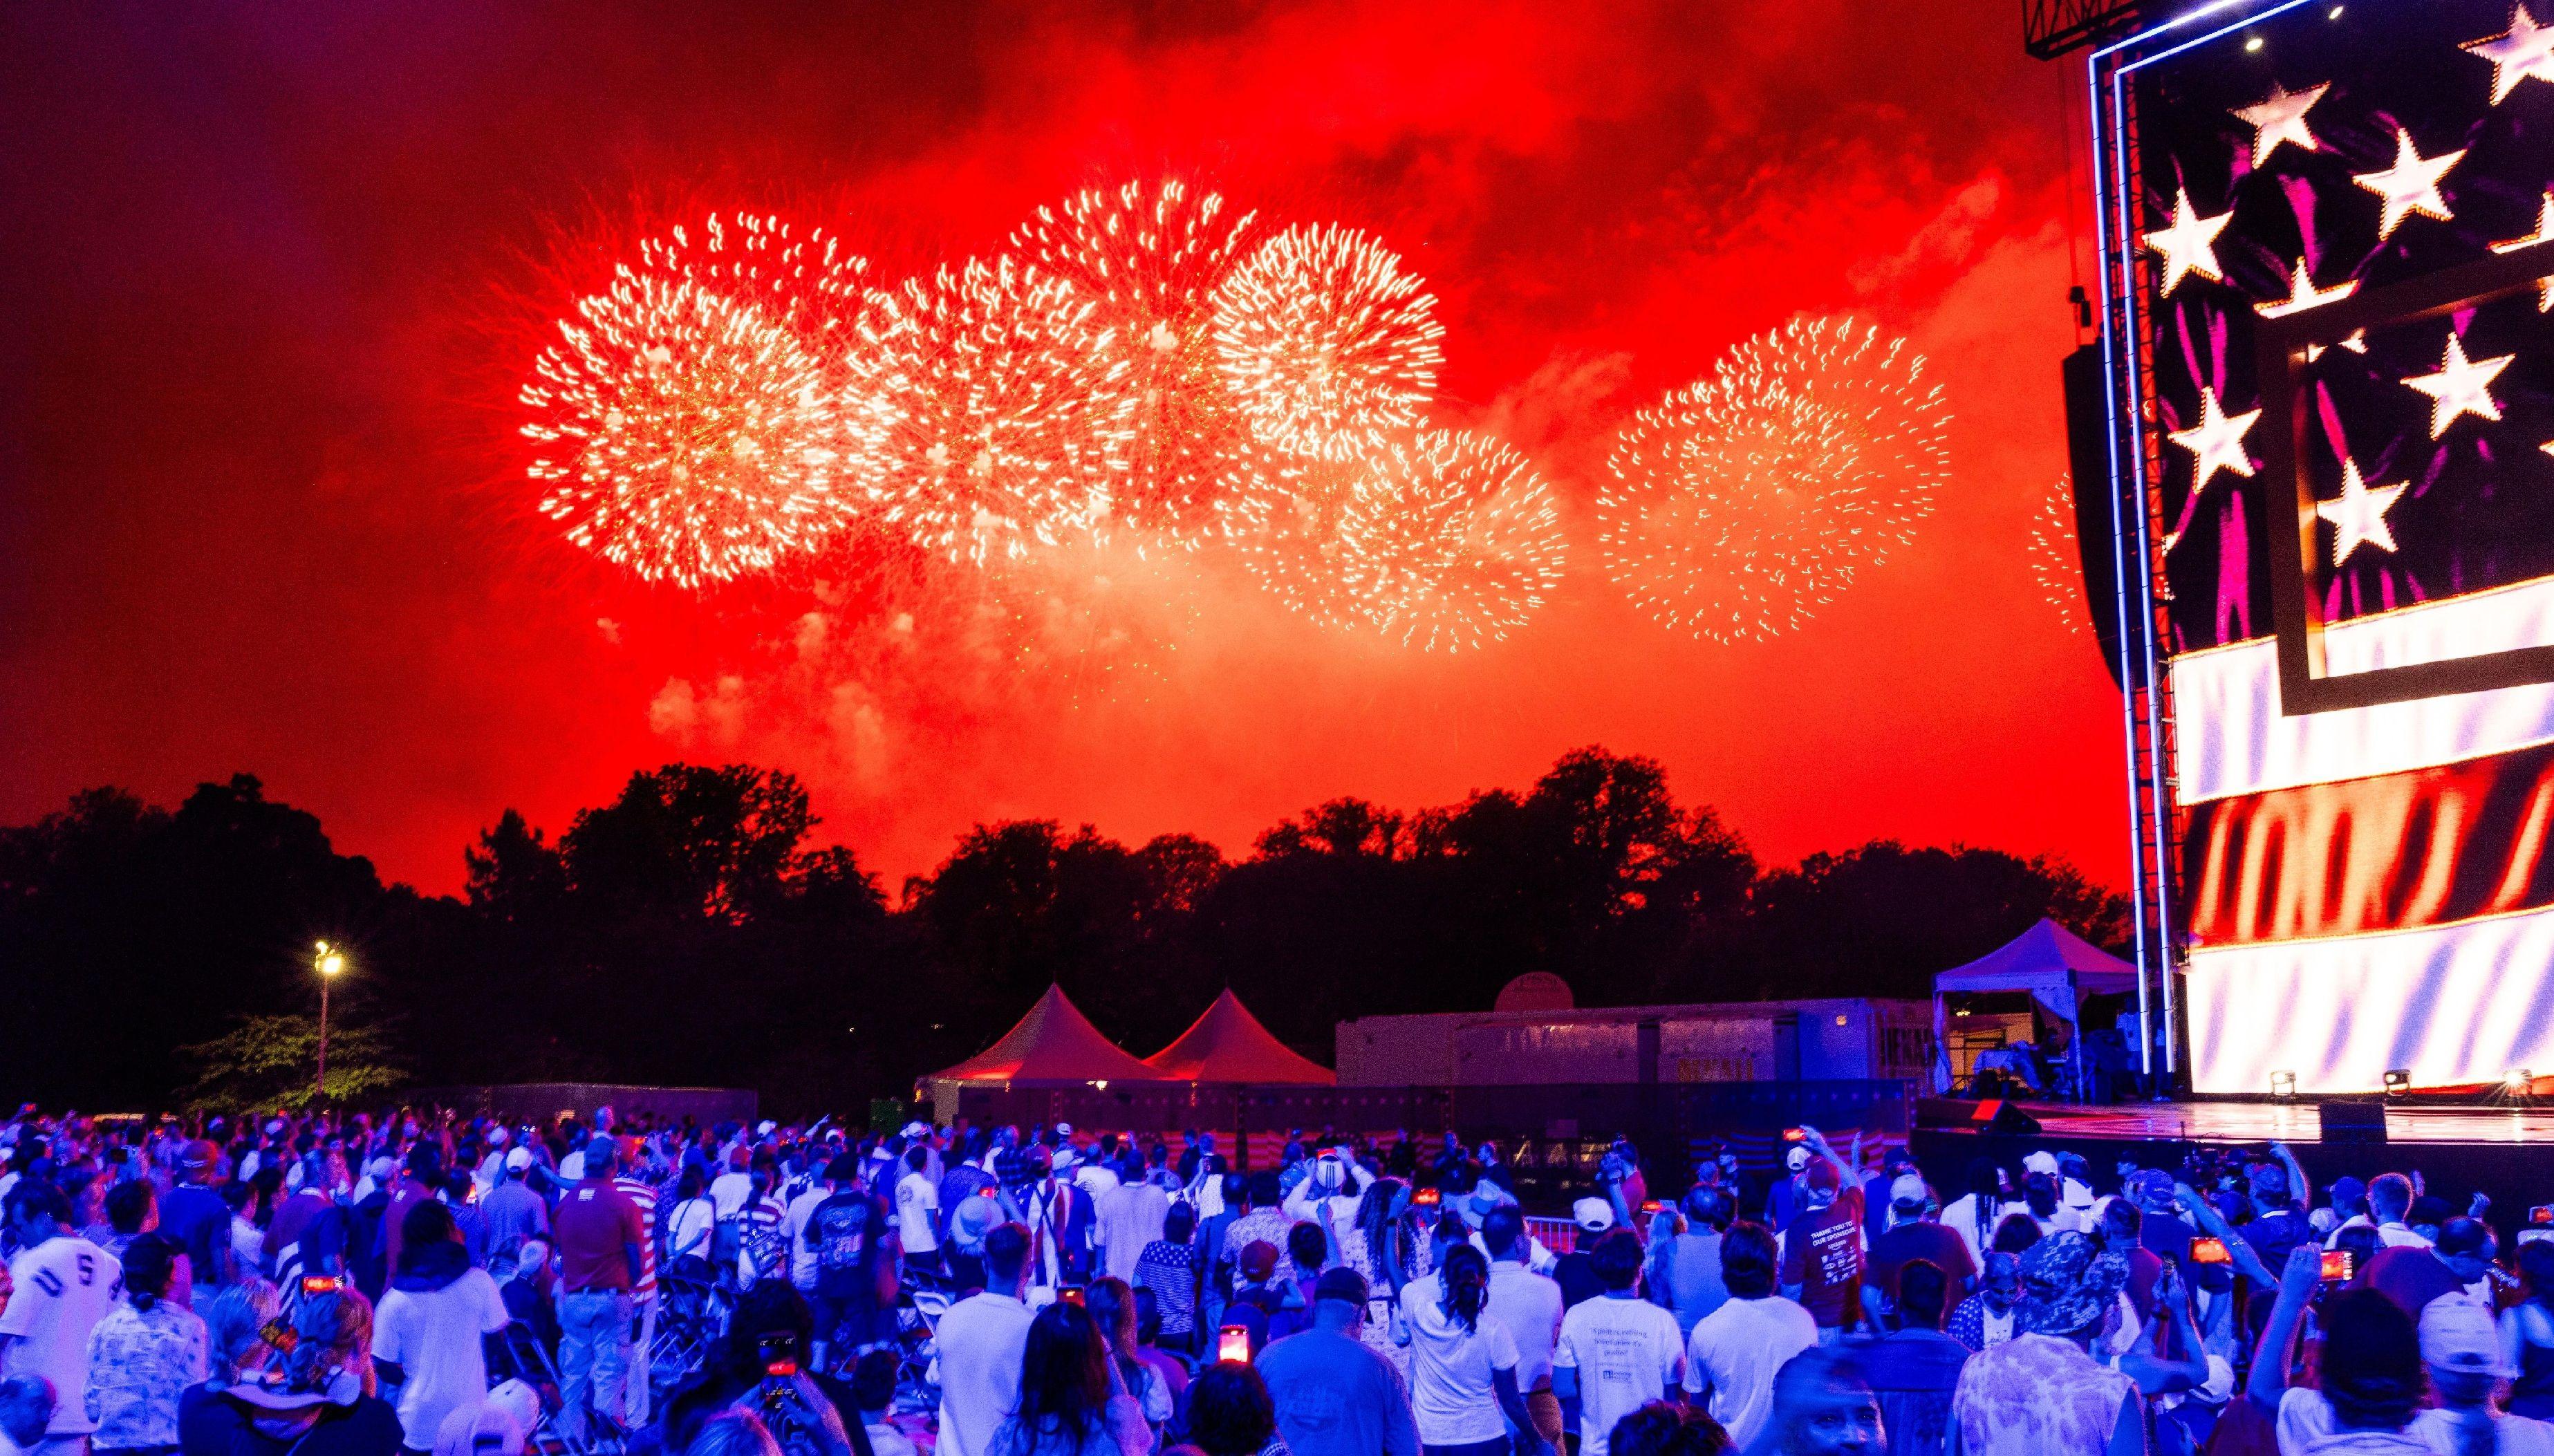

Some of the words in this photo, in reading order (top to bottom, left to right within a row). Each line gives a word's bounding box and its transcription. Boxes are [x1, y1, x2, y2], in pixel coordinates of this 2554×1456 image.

[1810, 1227, 1832, 1240] THANK
[1831, 1223, 1845, 1231] YOU
[1812, 1236, 1827, 1247] OUR
[1827, 1226, 1856, 1242] SPONSORS
